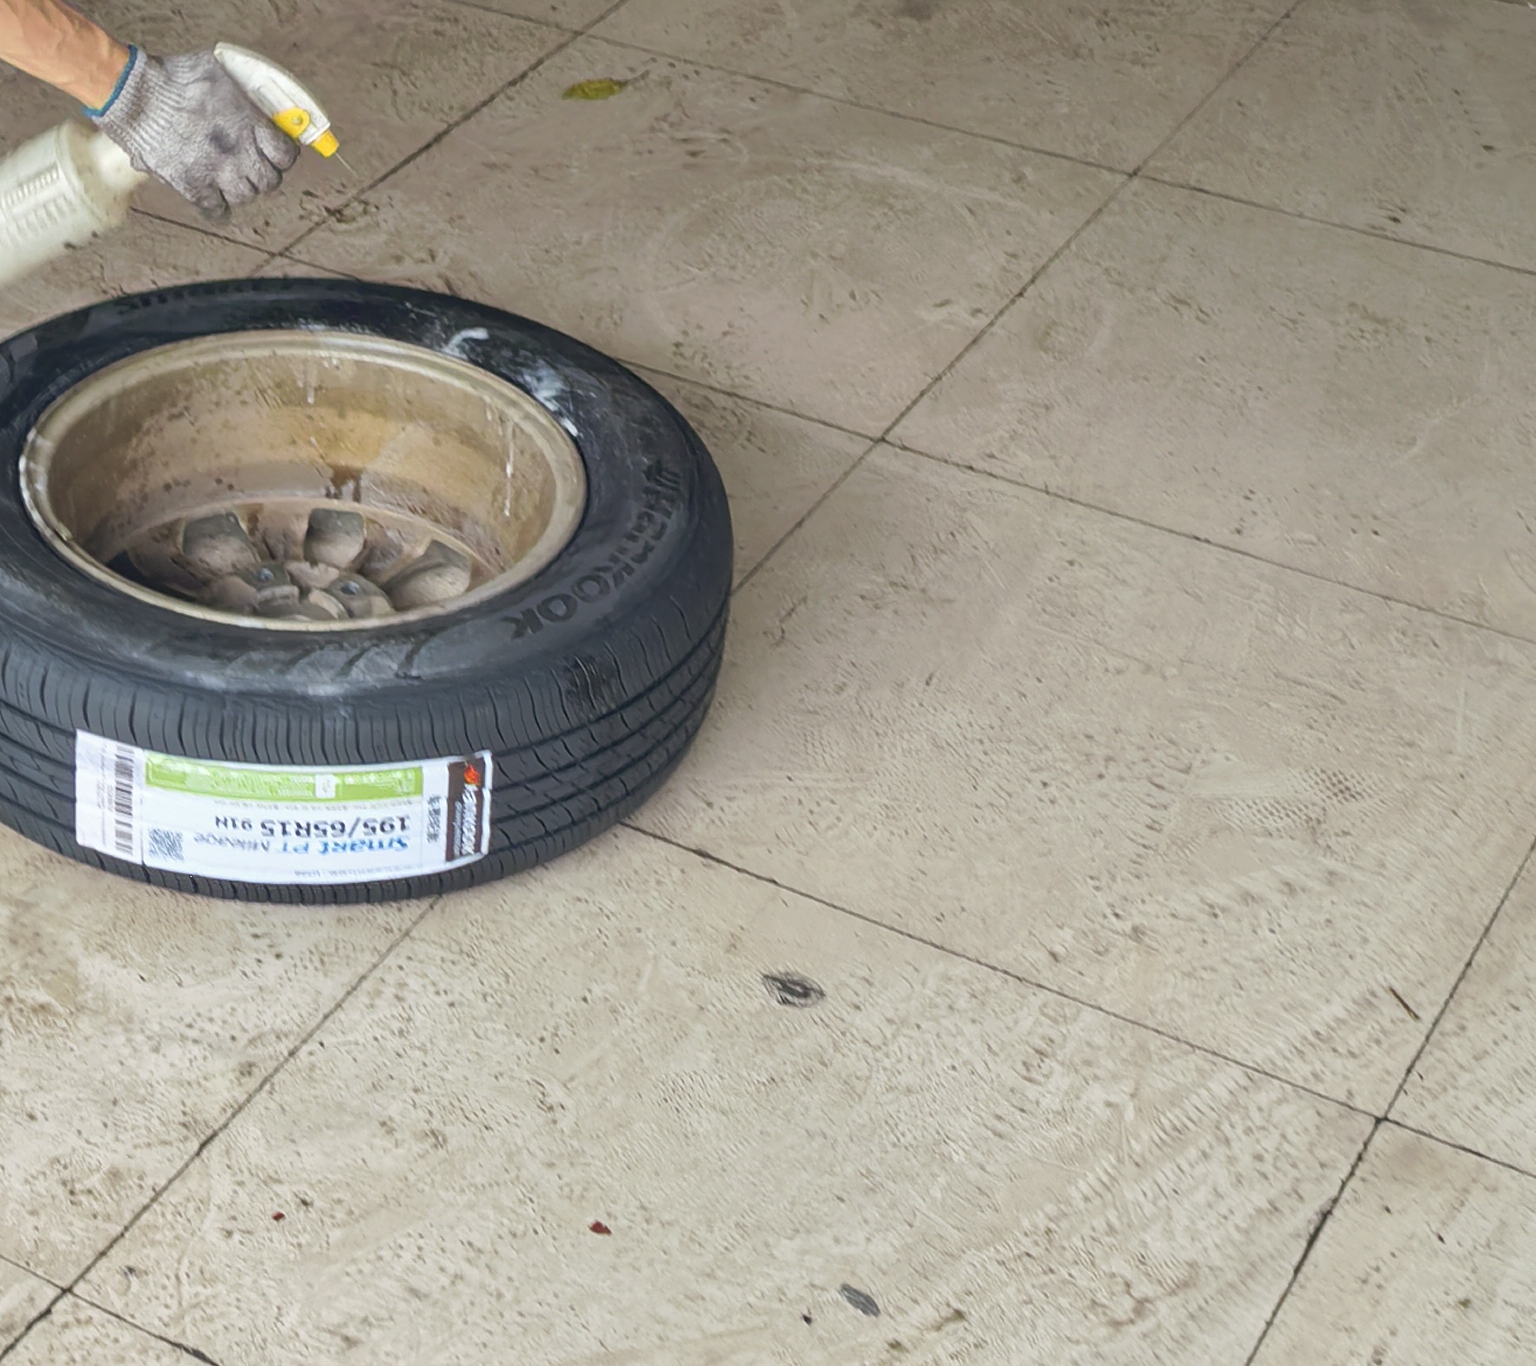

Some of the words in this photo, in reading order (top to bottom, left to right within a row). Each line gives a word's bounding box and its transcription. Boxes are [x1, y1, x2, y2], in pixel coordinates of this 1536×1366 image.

[261, 814, 412, 838] 195/65R15
[275, 837, 311, 855] PT
[316, 834, 410, 856] Smart
